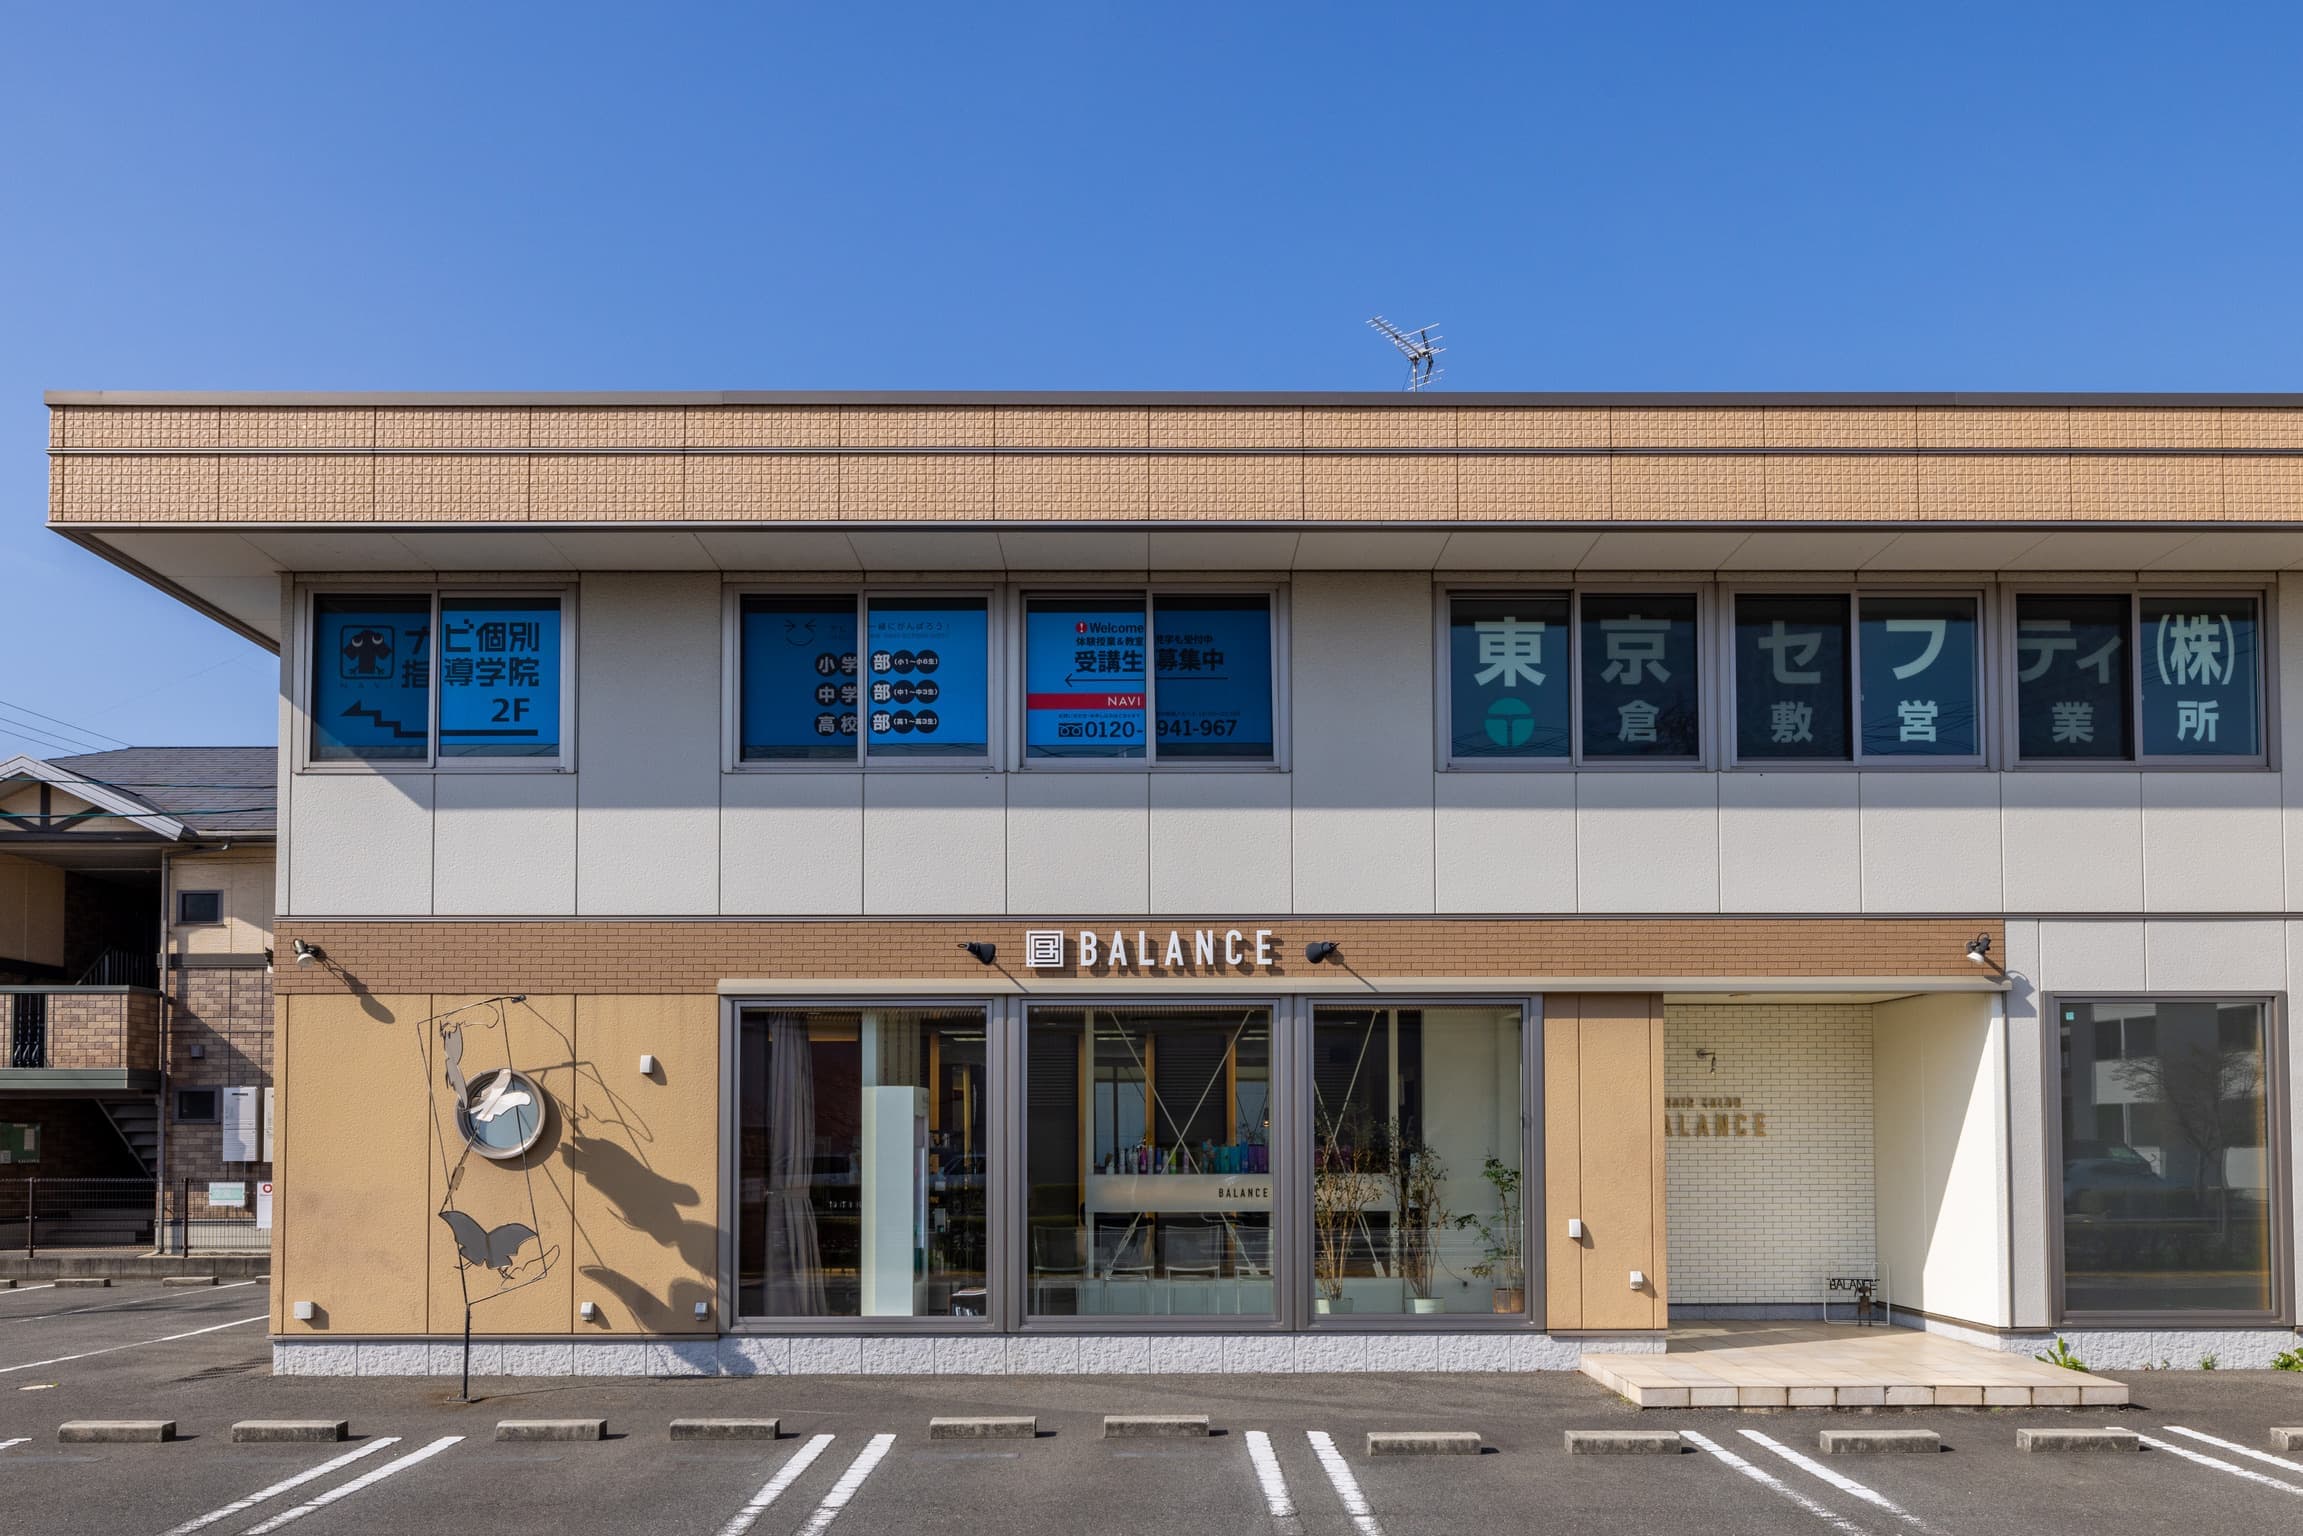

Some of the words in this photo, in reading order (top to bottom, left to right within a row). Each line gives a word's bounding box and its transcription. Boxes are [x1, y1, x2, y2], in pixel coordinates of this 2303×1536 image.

[1089, 622, 1144, 634] Welcome
[491, 697, 530, 722] 2F
[1107, 696, 1141, 706] NAVI
[1079, 929, 1273, 967] BALANCE
[1664, 1112, 1767, 1137] ALANCE
[1218, 1187, 1269, 1198] BALANCE
